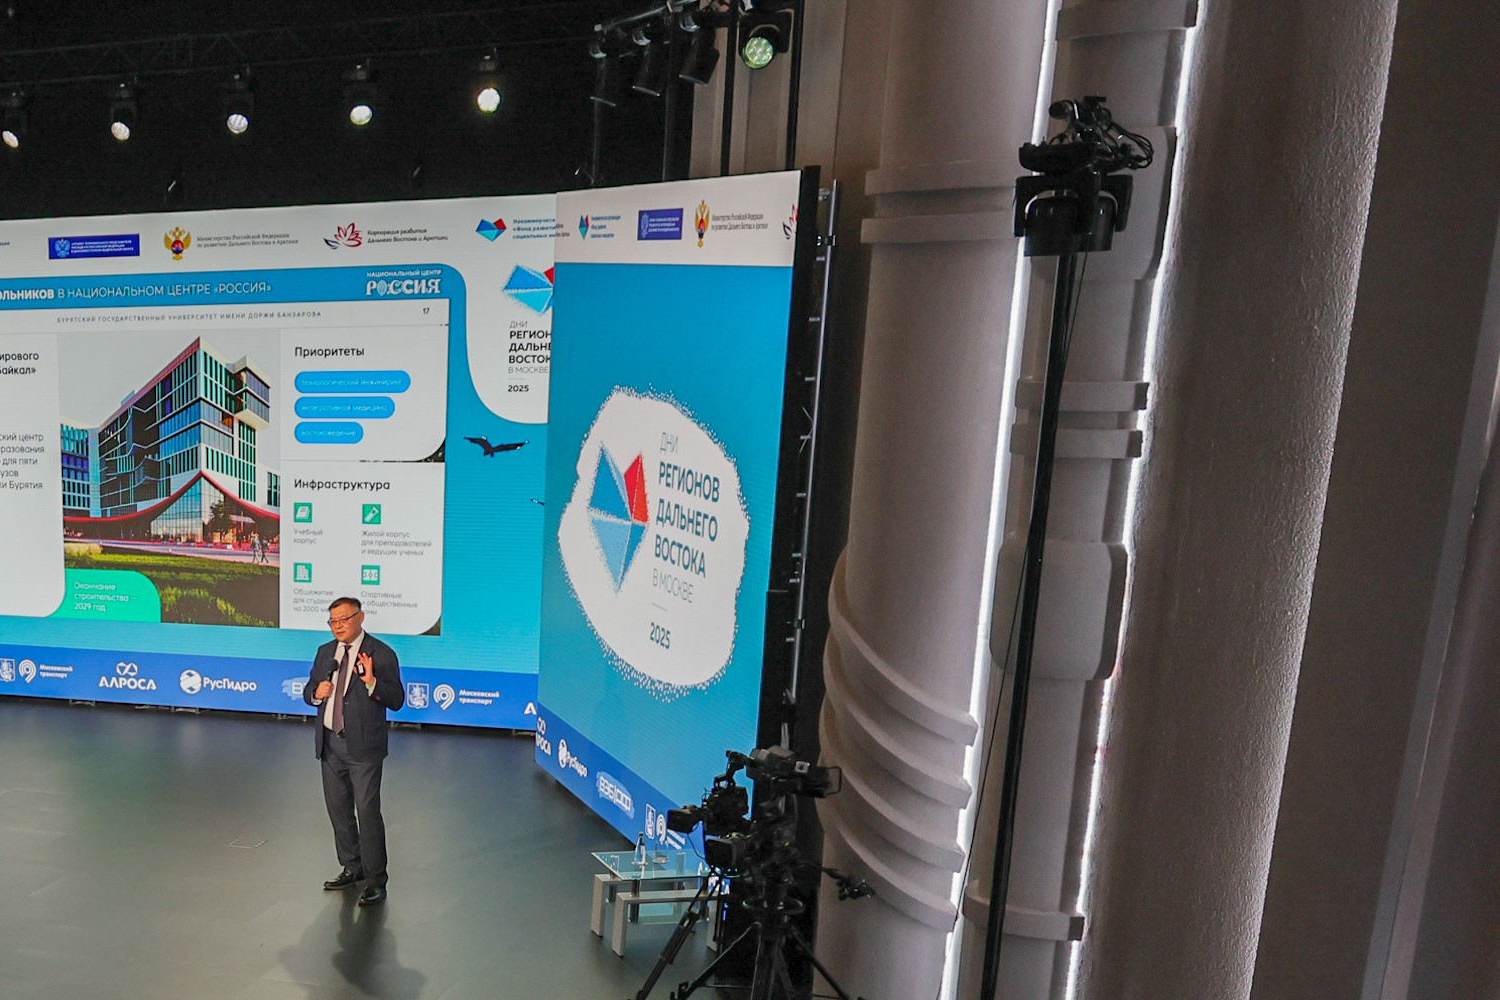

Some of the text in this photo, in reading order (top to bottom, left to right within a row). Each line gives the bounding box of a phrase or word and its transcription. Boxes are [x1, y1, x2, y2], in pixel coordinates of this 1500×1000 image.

[366, 269, 442, 278] НАЦИОНАЛЬНЫЙ ЦЕНТР
[57, 288, 65, 299] В
[67, 284, 164, 299] НАЦИОНАЛЬНОМ
[167, 283, 211, 296] ЦЕНТРЕ
[215, 282, 272, 294] «РОССИЯ»
[365, 278, 442, 297] РОССИЯ
[168, 313, 218, 321] УНИВЕРСИТЕТ
[248, 312, 274, 320] ДОРЖИ
[277, 311, 322, 319] БАНЗАРОВА
[509, 320, 528, 329] ДНИ
[510, 330, 552, 340] РЕГИОН
[294, 346, 365, 359] Приоритеты
[515, 366, 549, 374] МОСКВЕ
[507, 384, 530, 393] 2025
[18, 433, 44, 443] центр
[659, 432, 679, 455] ДНИ
[2, 458, 17, 466] для
[9, 480, 43, 490] Бурятия
[293, 478, 390, 492] Инфраструктура
[658, 461, 721, 504] РЕГИОНОВ
[655, 498, 719, 544] ДАЛЬНЕГО
[293, 528, 323, 536] Учебный
[361, 529, 410, 539] Жилой корпус
[654, 534, 706, 580] ВОСТОКА
[74, 581, 116, 591] Окончание
[652, 569, 693, 605] В МОСКВЕ
[74, 593, 129, 603] строительства
[361, 591, 402, 599] Спортивные
[74, 602, 106, 612] 2029 год
[649, 622, 671, 651] 2025
[39, 664, 74, 673] Московский
[39, 671, 69, 679] транспорт
[98, 675, 158, 692] АЛРОСА
[203, 676, 258, 693] РусГидро
[459, 689, 500, 699] Московский
[459, 697, 493, 706] транспорт
